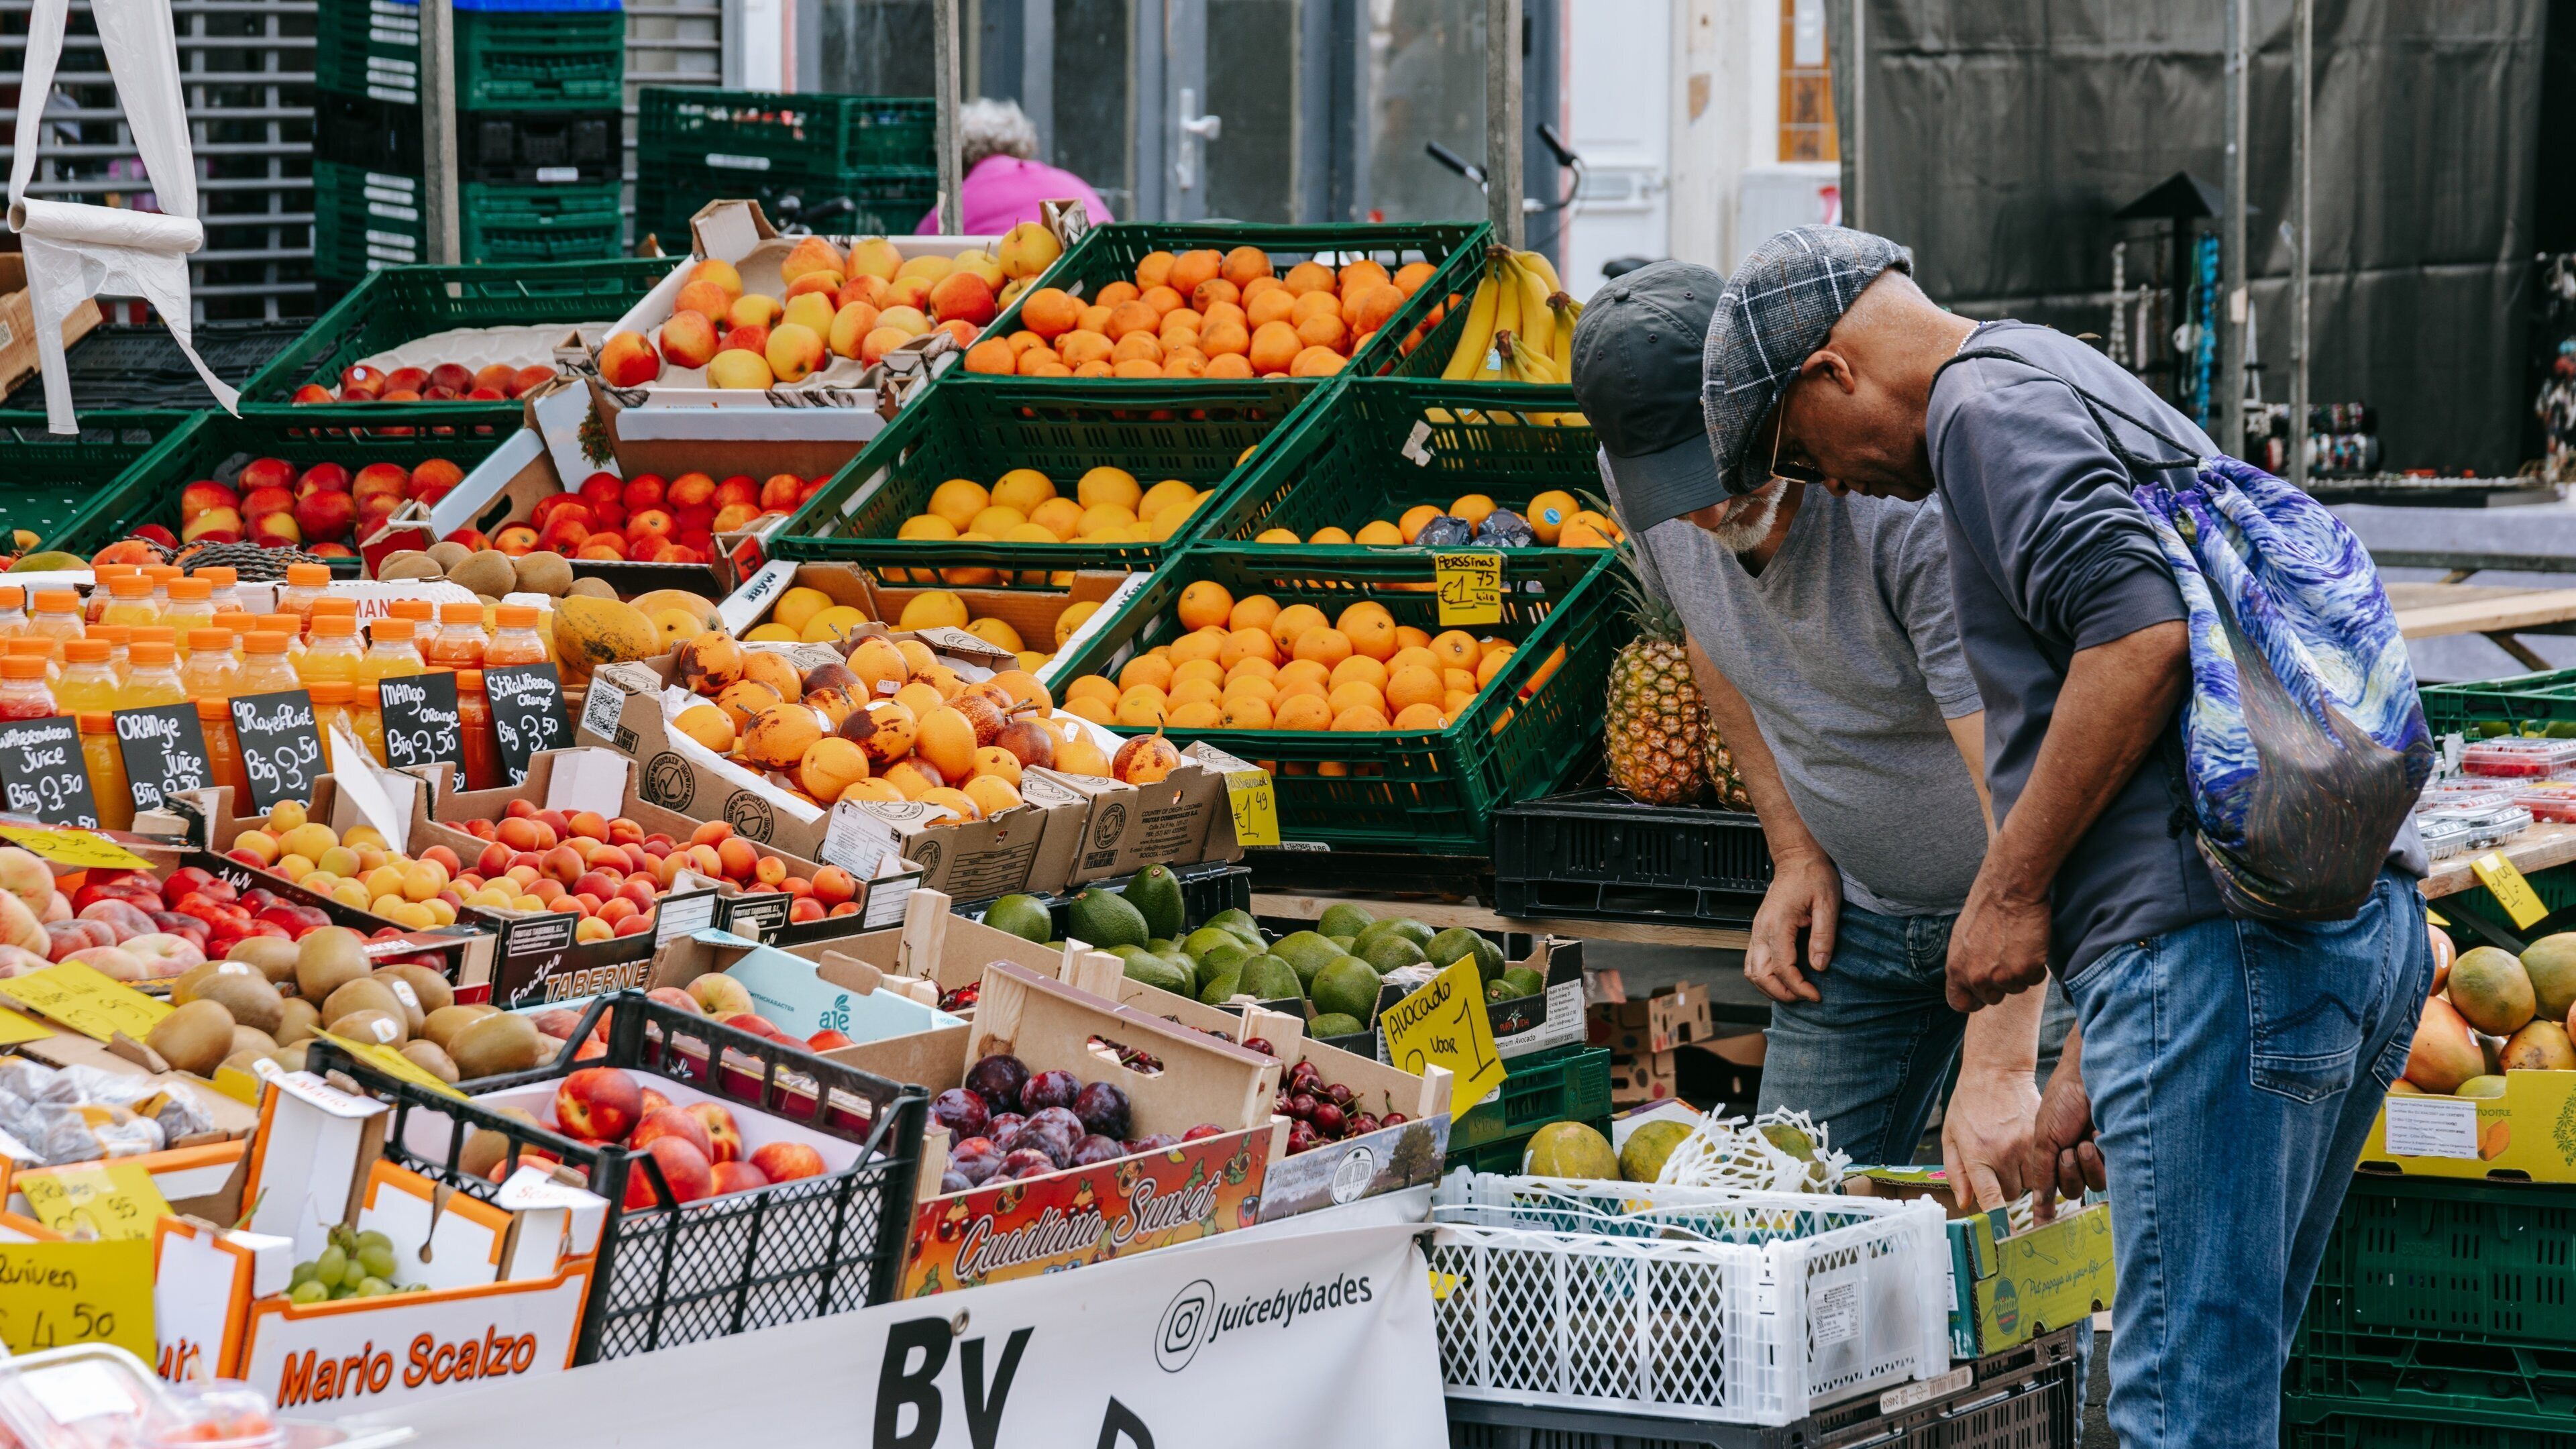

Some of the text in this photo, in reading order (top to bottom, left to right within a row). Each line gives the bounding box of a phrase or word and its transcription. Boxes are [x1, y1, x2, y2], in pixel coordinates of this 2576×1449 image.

[1515, 1033, 1536, 1044] Avocado
[1111, 1169, 1222, 1247] Sunset
[276, 1323, 537, 1409] Mario Scalzo
